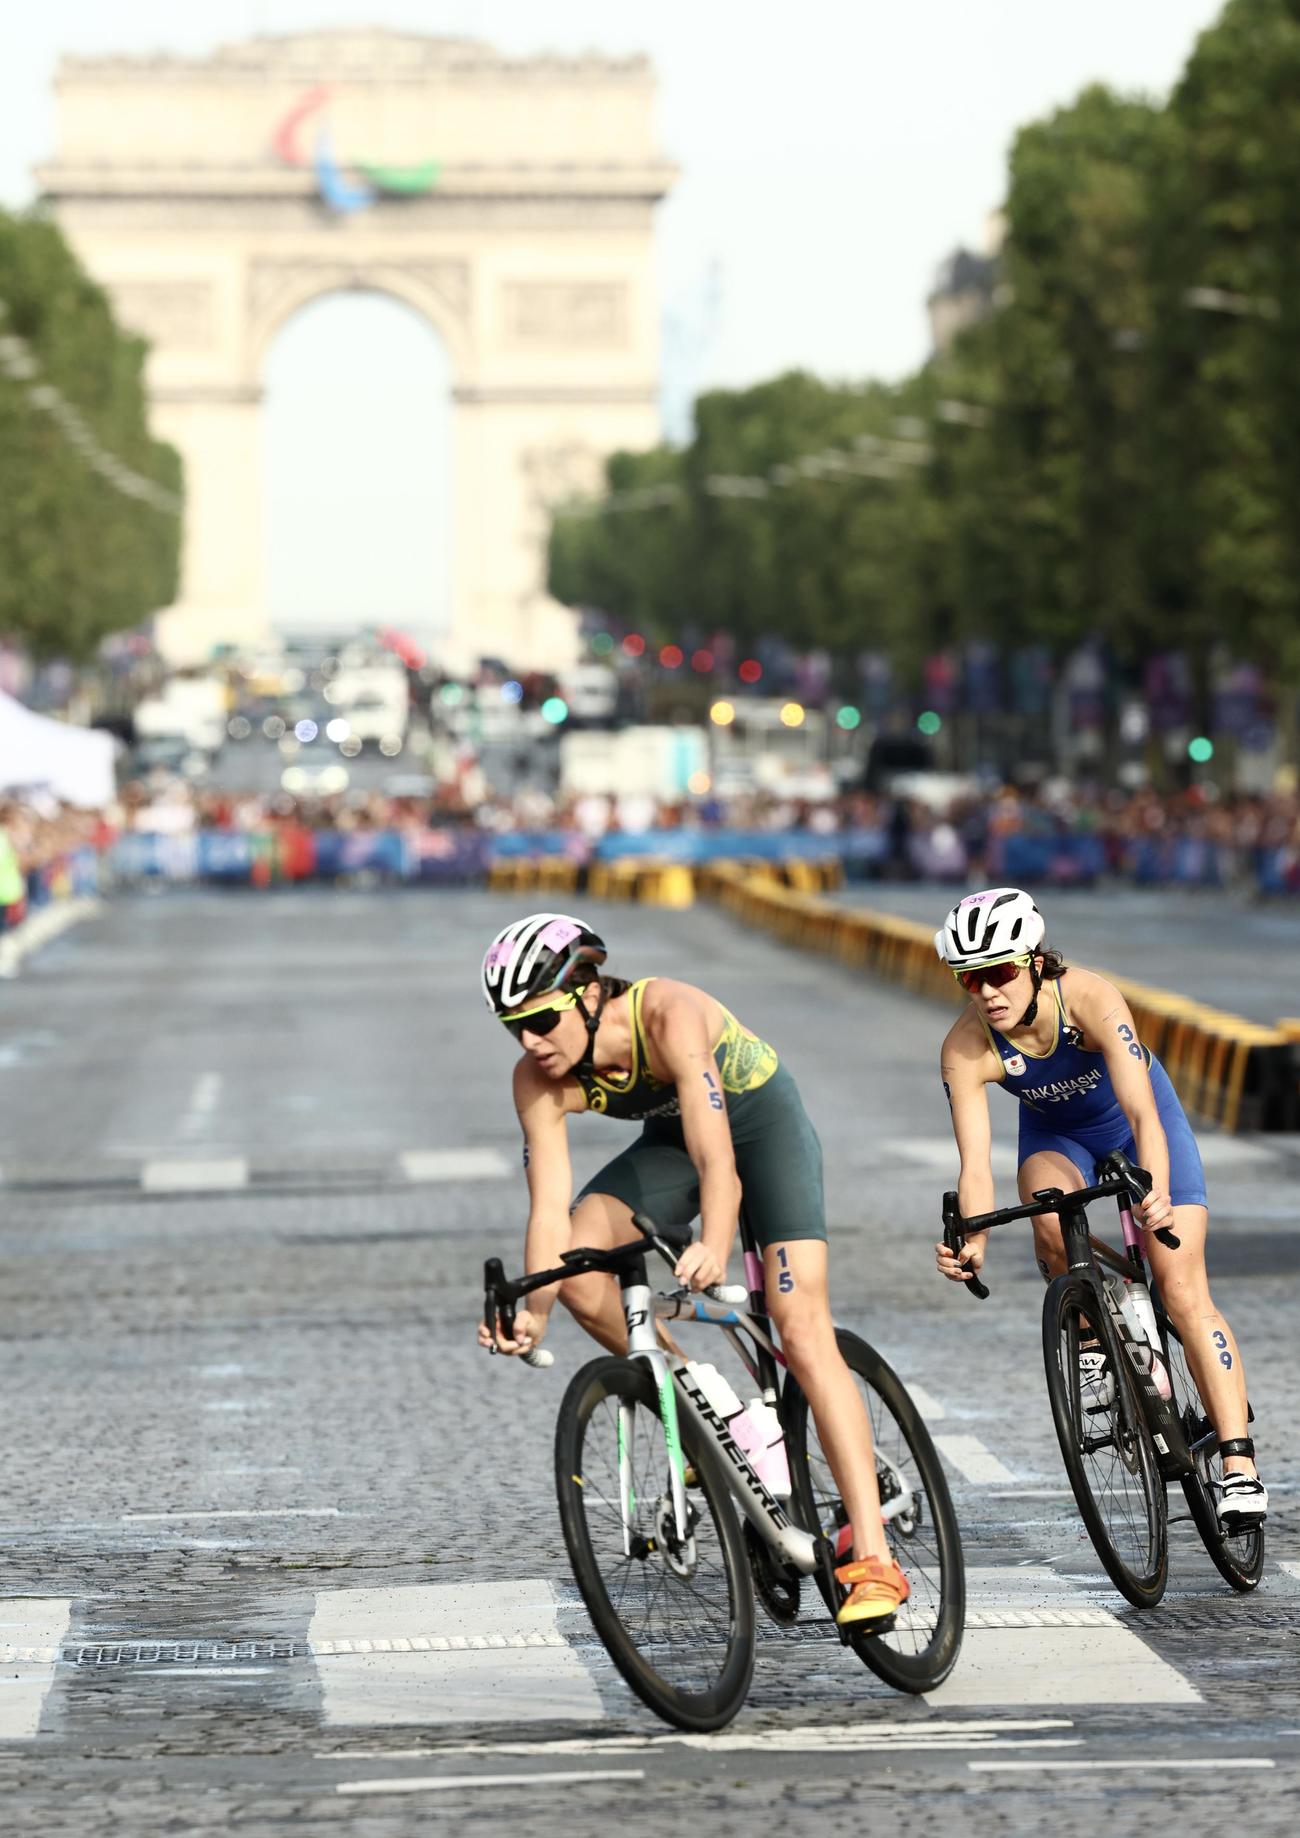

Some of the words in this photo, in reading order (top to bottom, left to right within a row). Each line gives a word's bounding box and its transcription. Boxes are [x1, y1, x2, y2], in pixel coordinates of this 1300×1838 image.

[1117, 1023, 1142, 1060] 39
[703, 1071, 724, 1110] 15
[1021, 1068, 1102, 1101] TAKAHASHI
[776, 1246, 794, 1293] 15
[1211, 1330, 1233, 1370] 39
[673, 1366, 793, 1532] LAPIERRE
